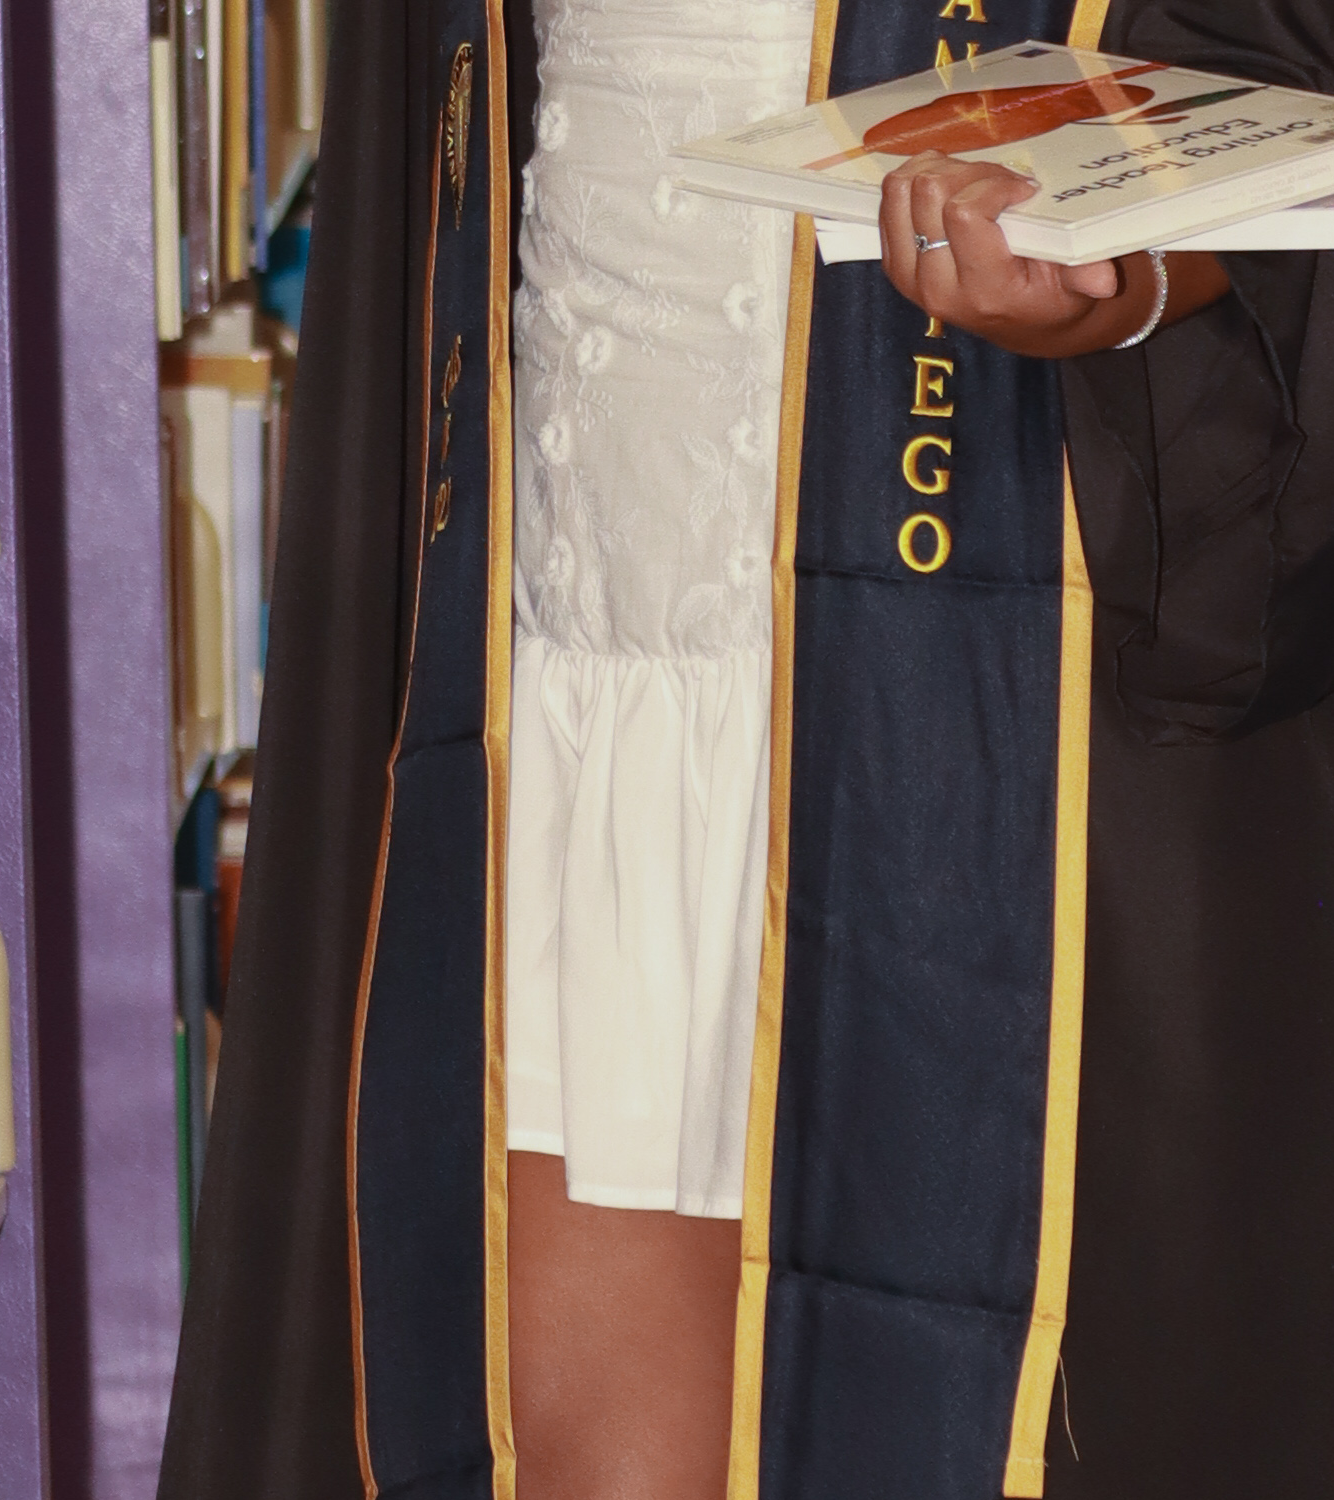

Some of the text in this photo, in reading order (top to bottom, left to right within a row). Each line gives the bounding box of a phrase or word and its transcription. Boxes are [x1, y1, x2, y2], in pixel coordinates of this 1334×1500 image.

[1050, 118, 1317, 206] orming Teacher
[1077, 117, 1261, 174] Education
